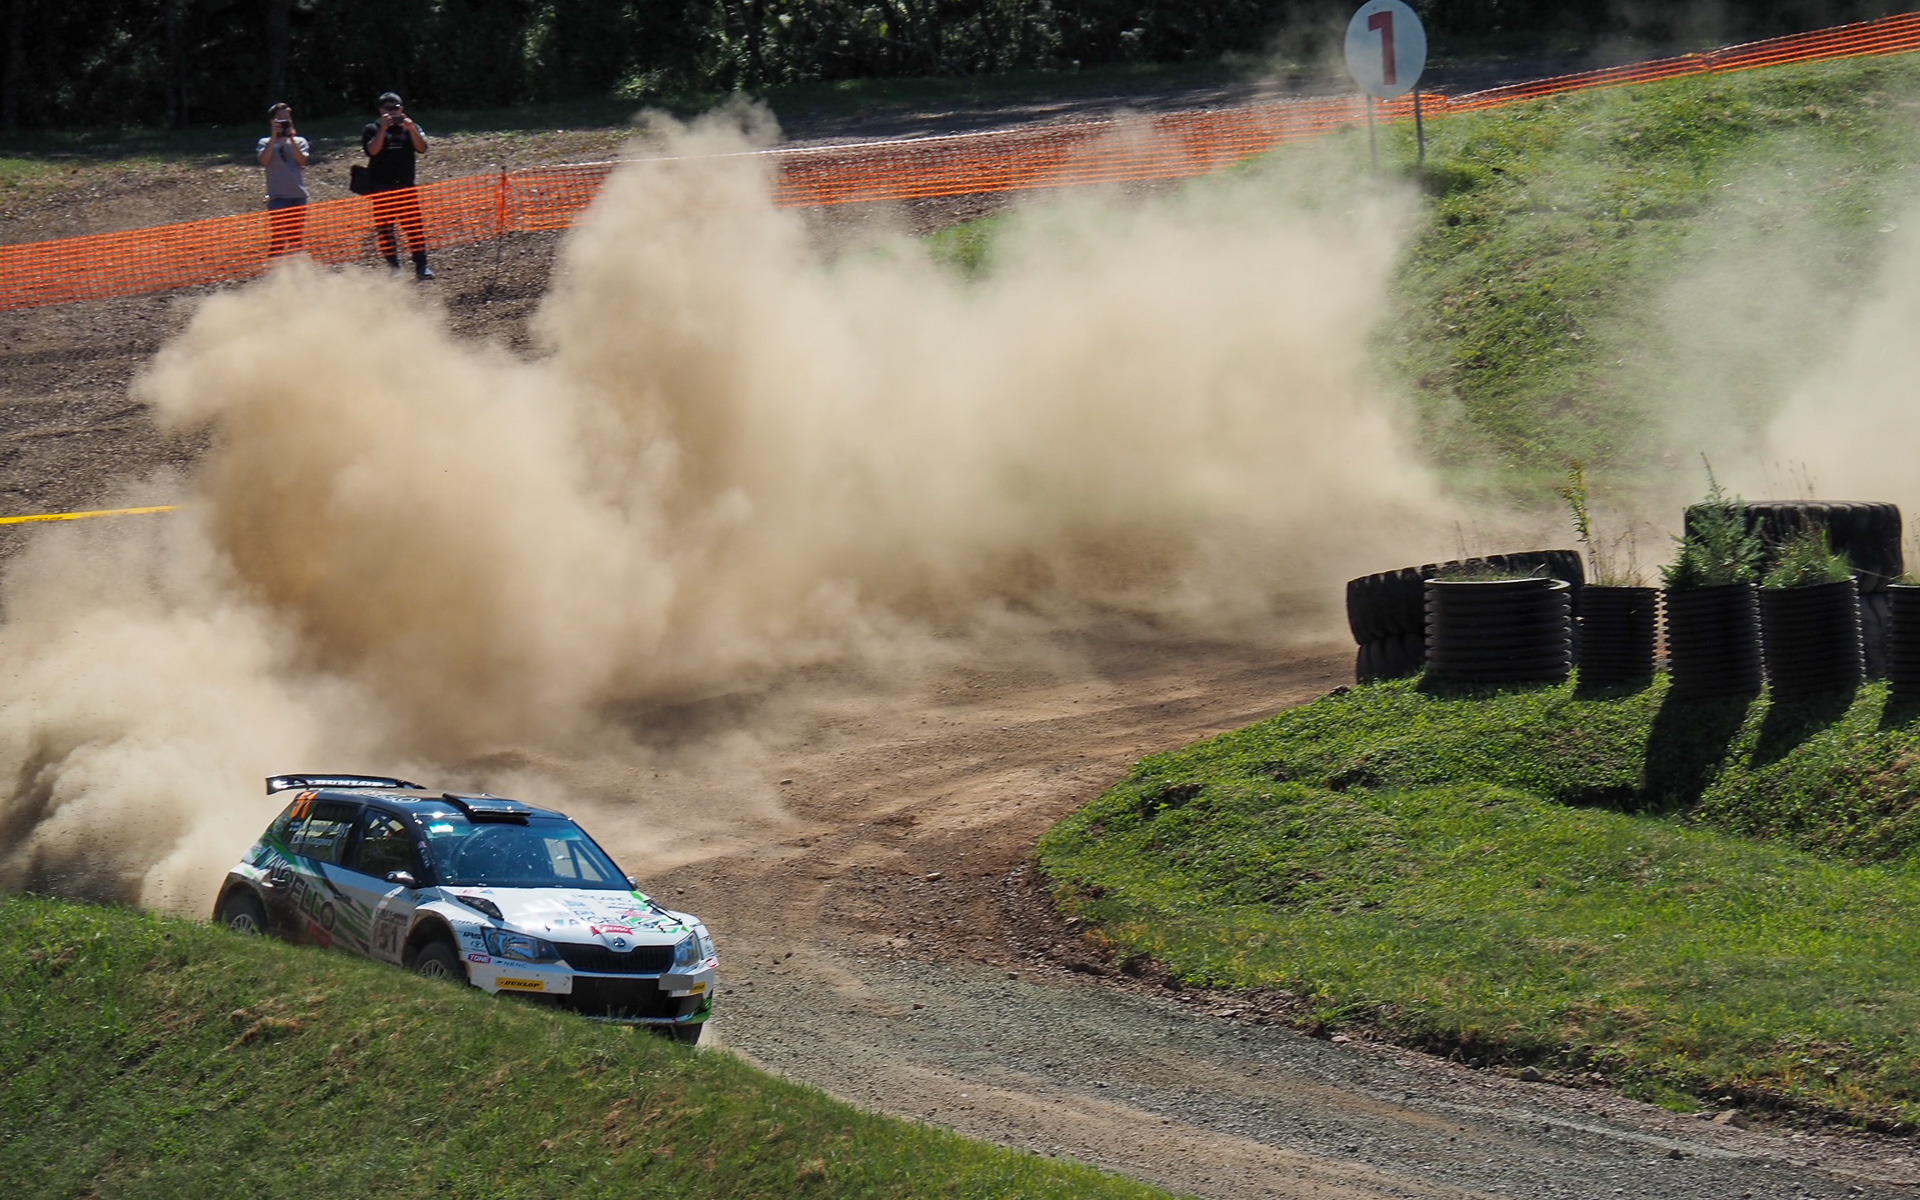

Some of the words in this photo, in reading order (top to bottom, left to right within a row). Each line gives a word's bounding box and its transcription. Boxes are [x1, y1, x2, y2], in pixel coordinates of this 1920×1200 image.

[1368, 11, 1396, 85] 1
[470, 954, 489, 963] TONE
[504, 980, 540, 988] DUNLOP
